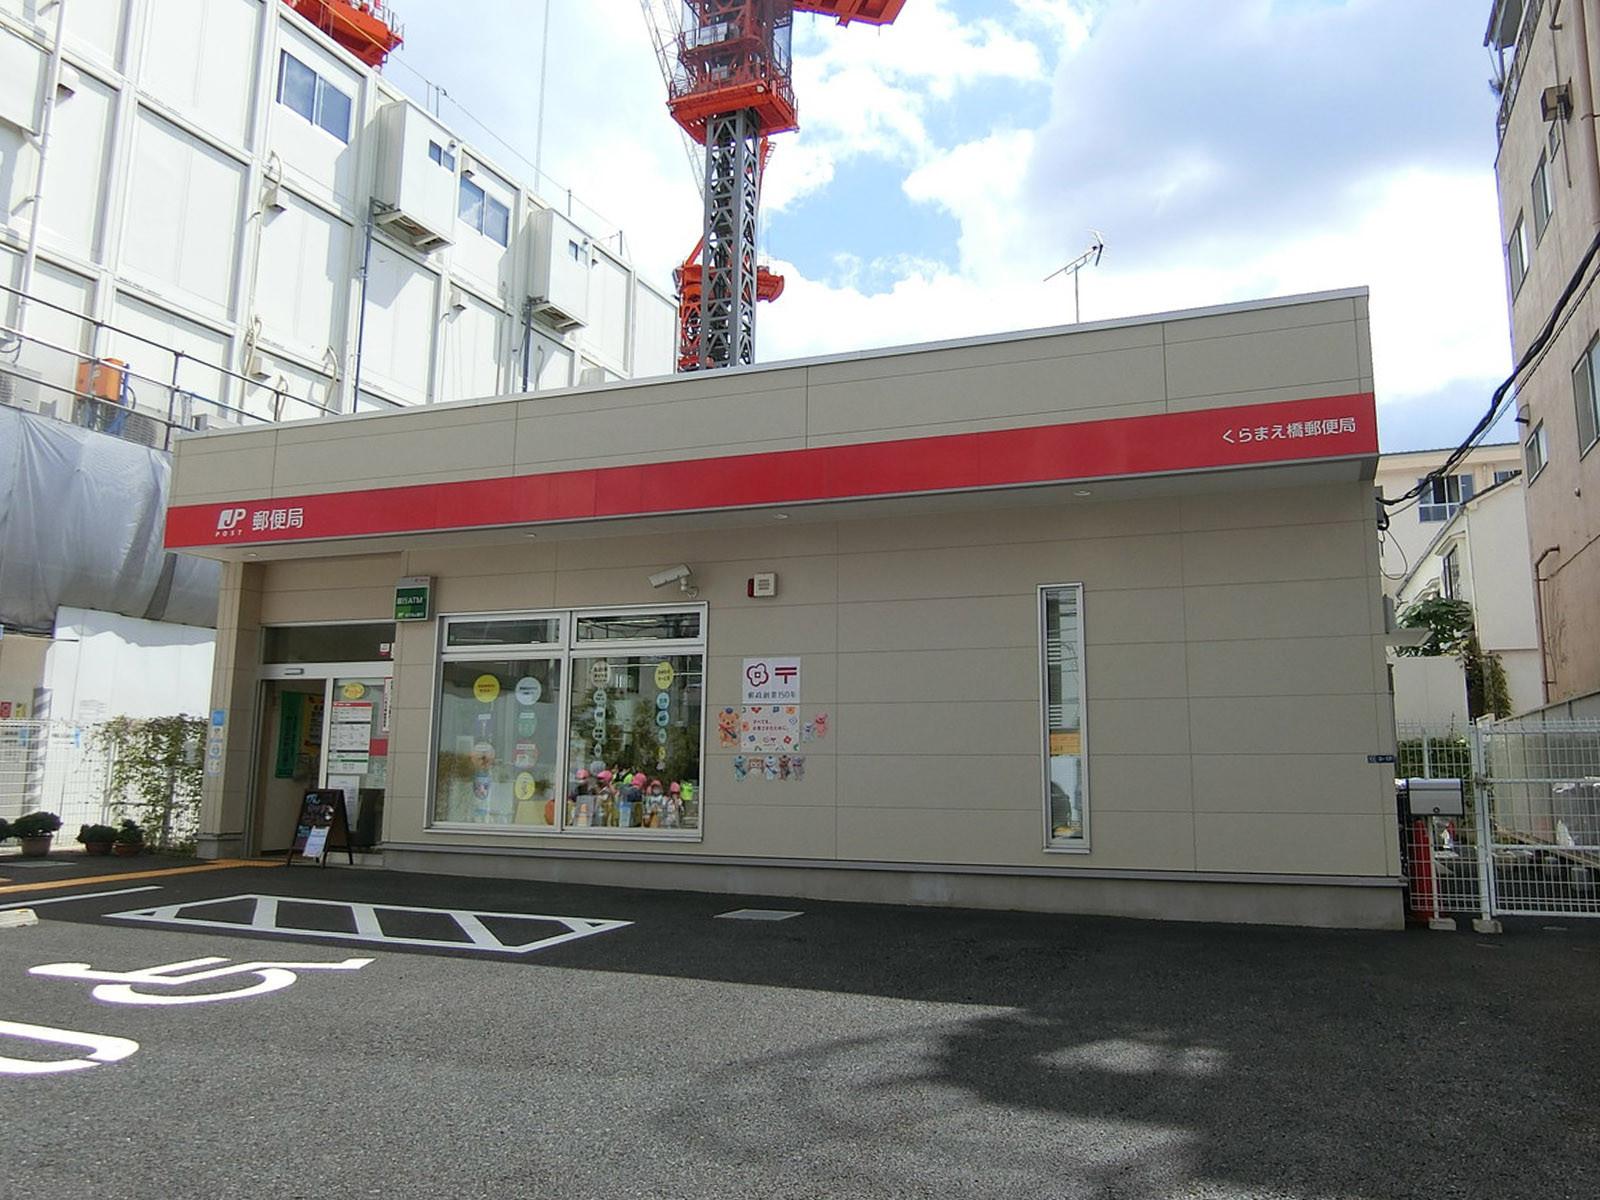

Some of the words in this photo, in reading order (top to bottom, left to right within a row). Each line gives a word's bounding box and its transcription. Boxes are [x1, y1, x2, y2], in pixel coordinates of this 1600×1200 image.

[1222, 417, 1356, 444] くらまえ橋郵便局
[252, 508, 304, 531] 郵便局
[215, 529, 243, 537] POST
